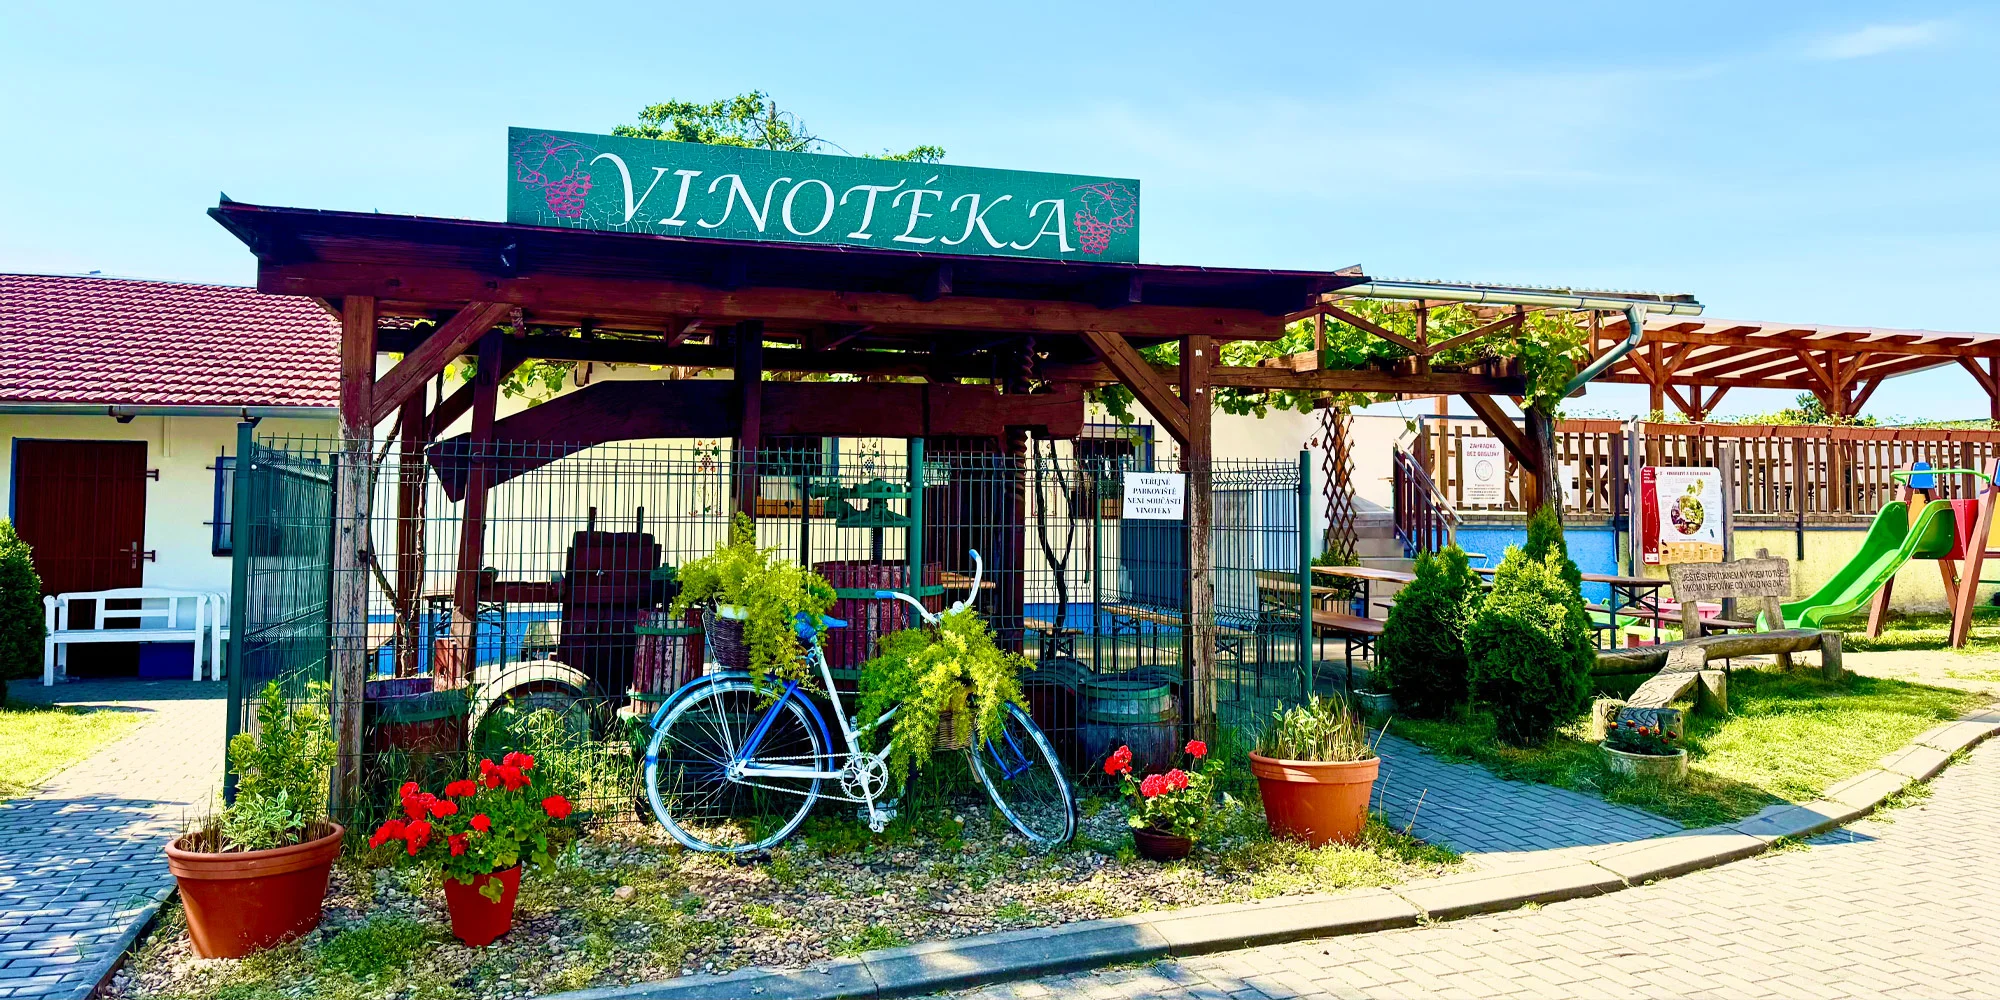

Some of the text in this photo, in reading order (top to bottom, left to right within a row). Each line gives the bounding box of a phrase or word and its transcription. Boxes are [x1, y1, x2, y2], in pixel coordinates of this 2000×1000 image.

[590, 152, 1076, 253] VINOTÉKA
[1140, 477, 1171, 486] VEŘEJNÉ
[1133, 487, 1176, 495] PARKOVIŠTĚ
[1127, 496, 1181, 505] NENÍ SOUČÁSTÍ
[1135, 506, 1171, 514] VINOTÉKY
